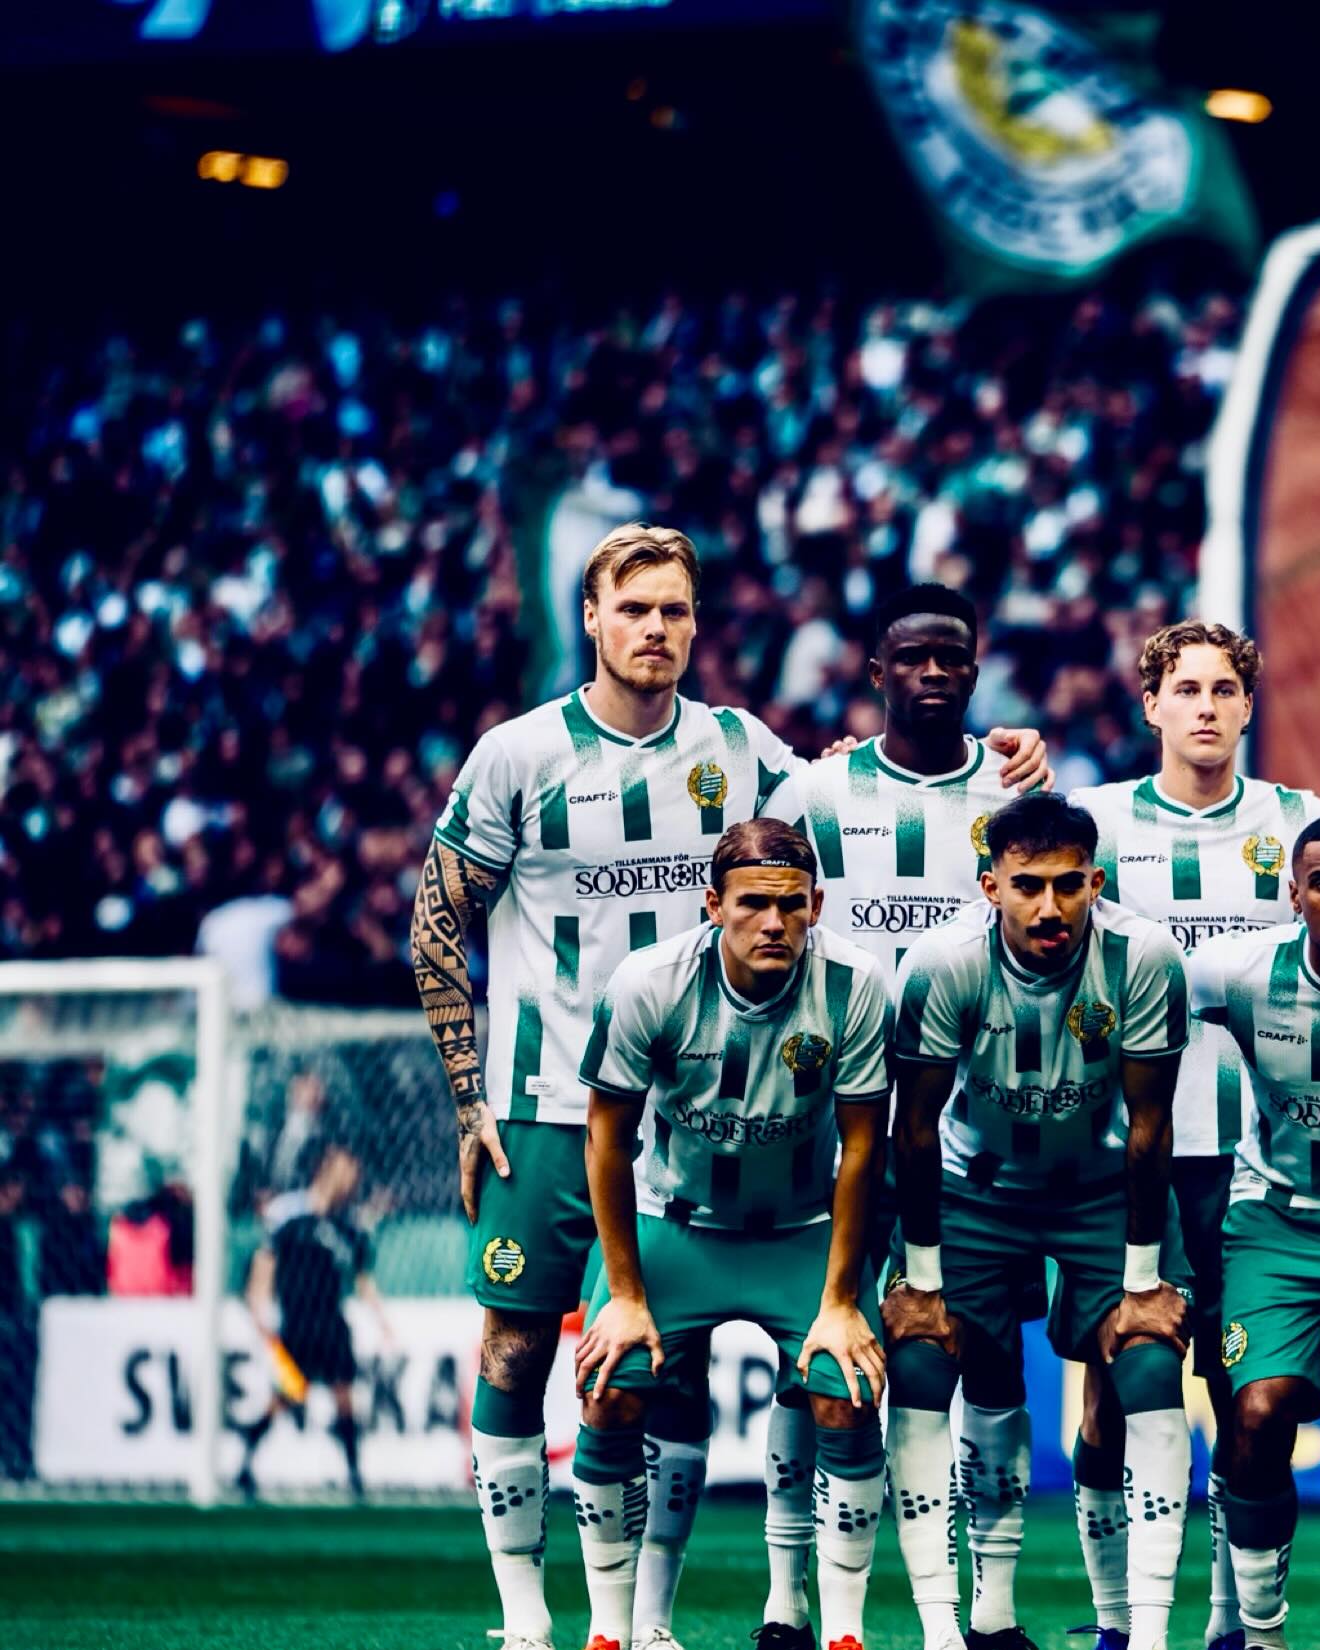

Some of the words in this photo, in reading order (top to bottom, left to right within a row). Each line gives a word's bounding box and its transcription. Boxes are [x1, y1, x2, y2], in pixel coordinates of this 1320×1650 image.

[569, 793, 607, 805] CRAFT
[843, 828, 879, 836] CRAFT
[615, 855, 672, 868] TILLSAMMANS
[672, 854, 690, 864] FÖR
[760, 859, 786, 867] CRAFT
[1119, 855, 1156, 864] CRAFT
[887, 895, 945, 904] TILLSAMMANS
[946, 896, 961, 905] FÖR
[1168, 915, 1227, 923] TILLSAMMANS
[1229, 914, 1246, 923] FÖR
[1257, 1030, 1296, 1044] CRAFT
